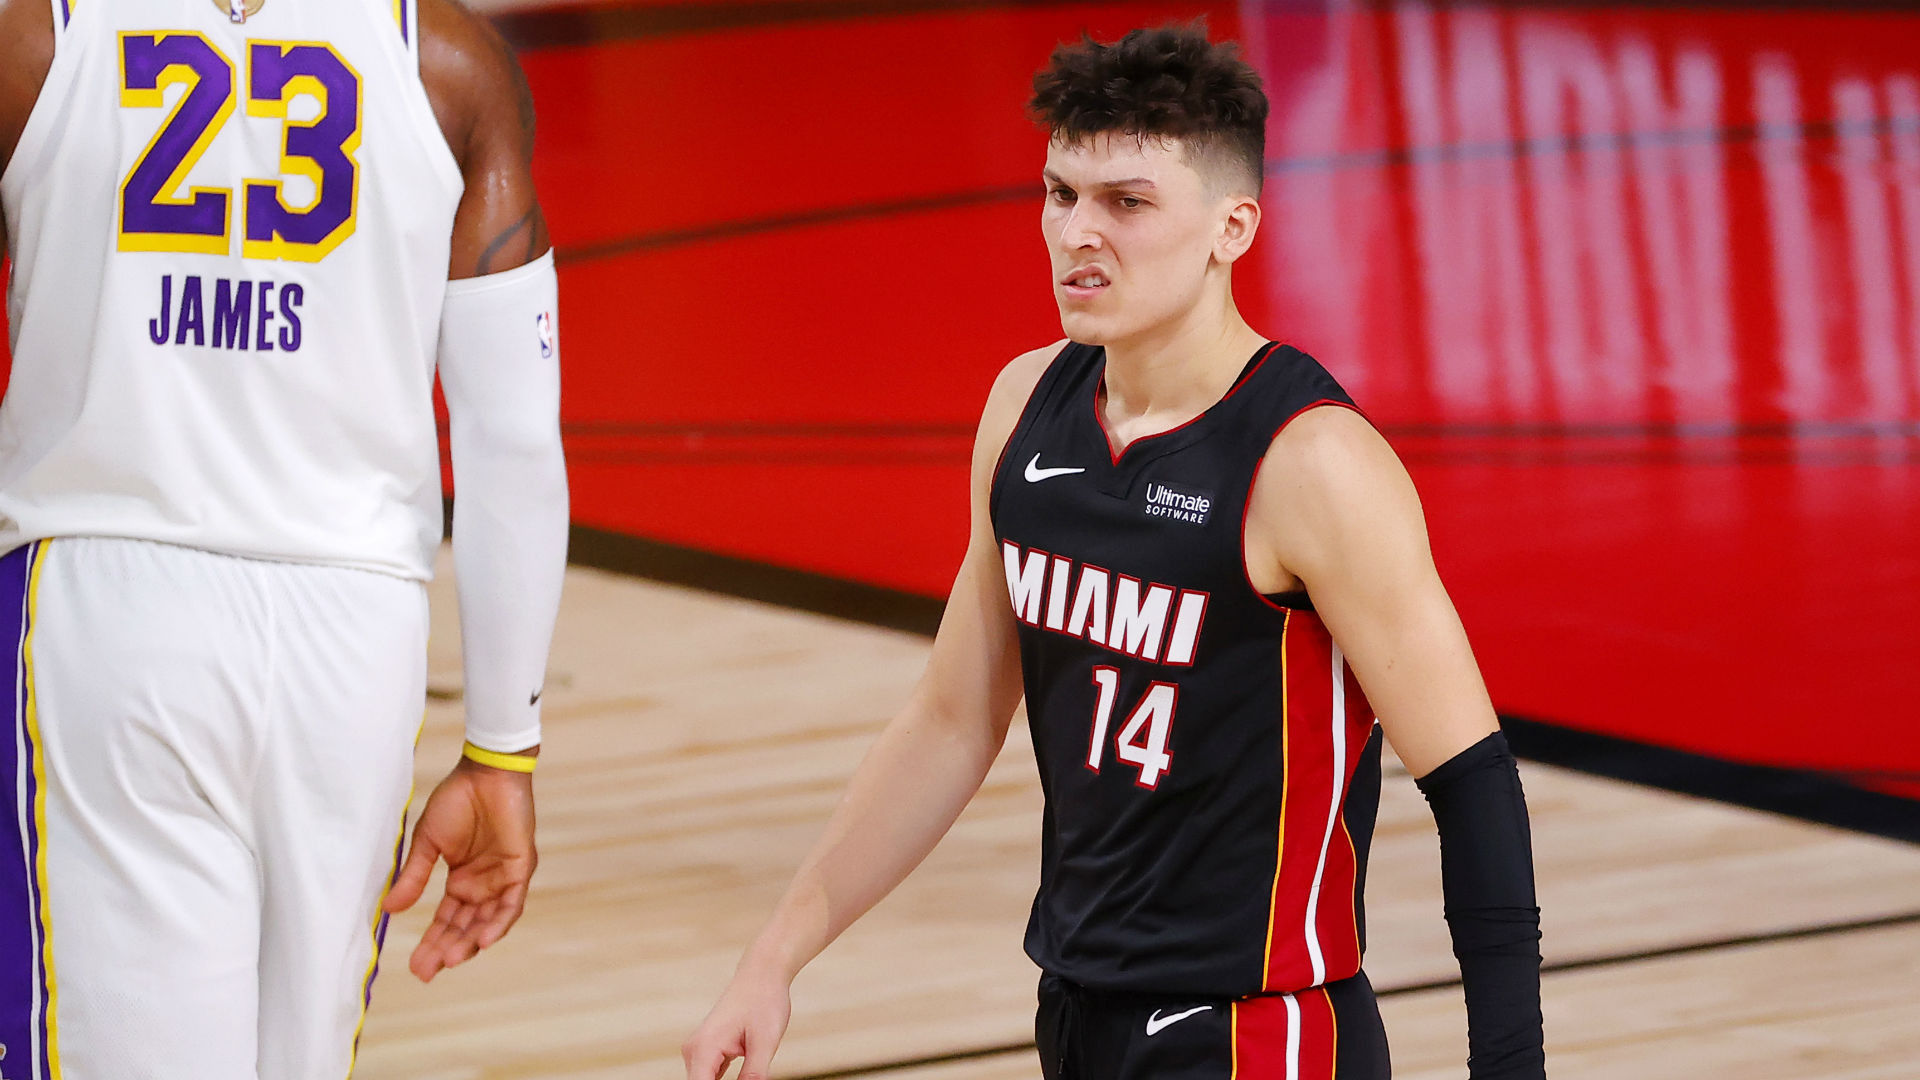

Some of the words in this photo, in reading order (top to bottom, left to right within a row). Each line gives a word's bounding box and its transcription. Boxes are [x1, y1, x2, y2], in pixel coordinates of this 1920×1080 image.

[117, 30, 363, 263] 23
[149, 274, 304, 352] JAMES
[1145, 504, 1204, 524] SOFTWARE
[1146, 483, 1210, 512] Ultimate
[1002, 538, 1210, 667] MIAMI
[1085, 664, 1179, 791] 14
